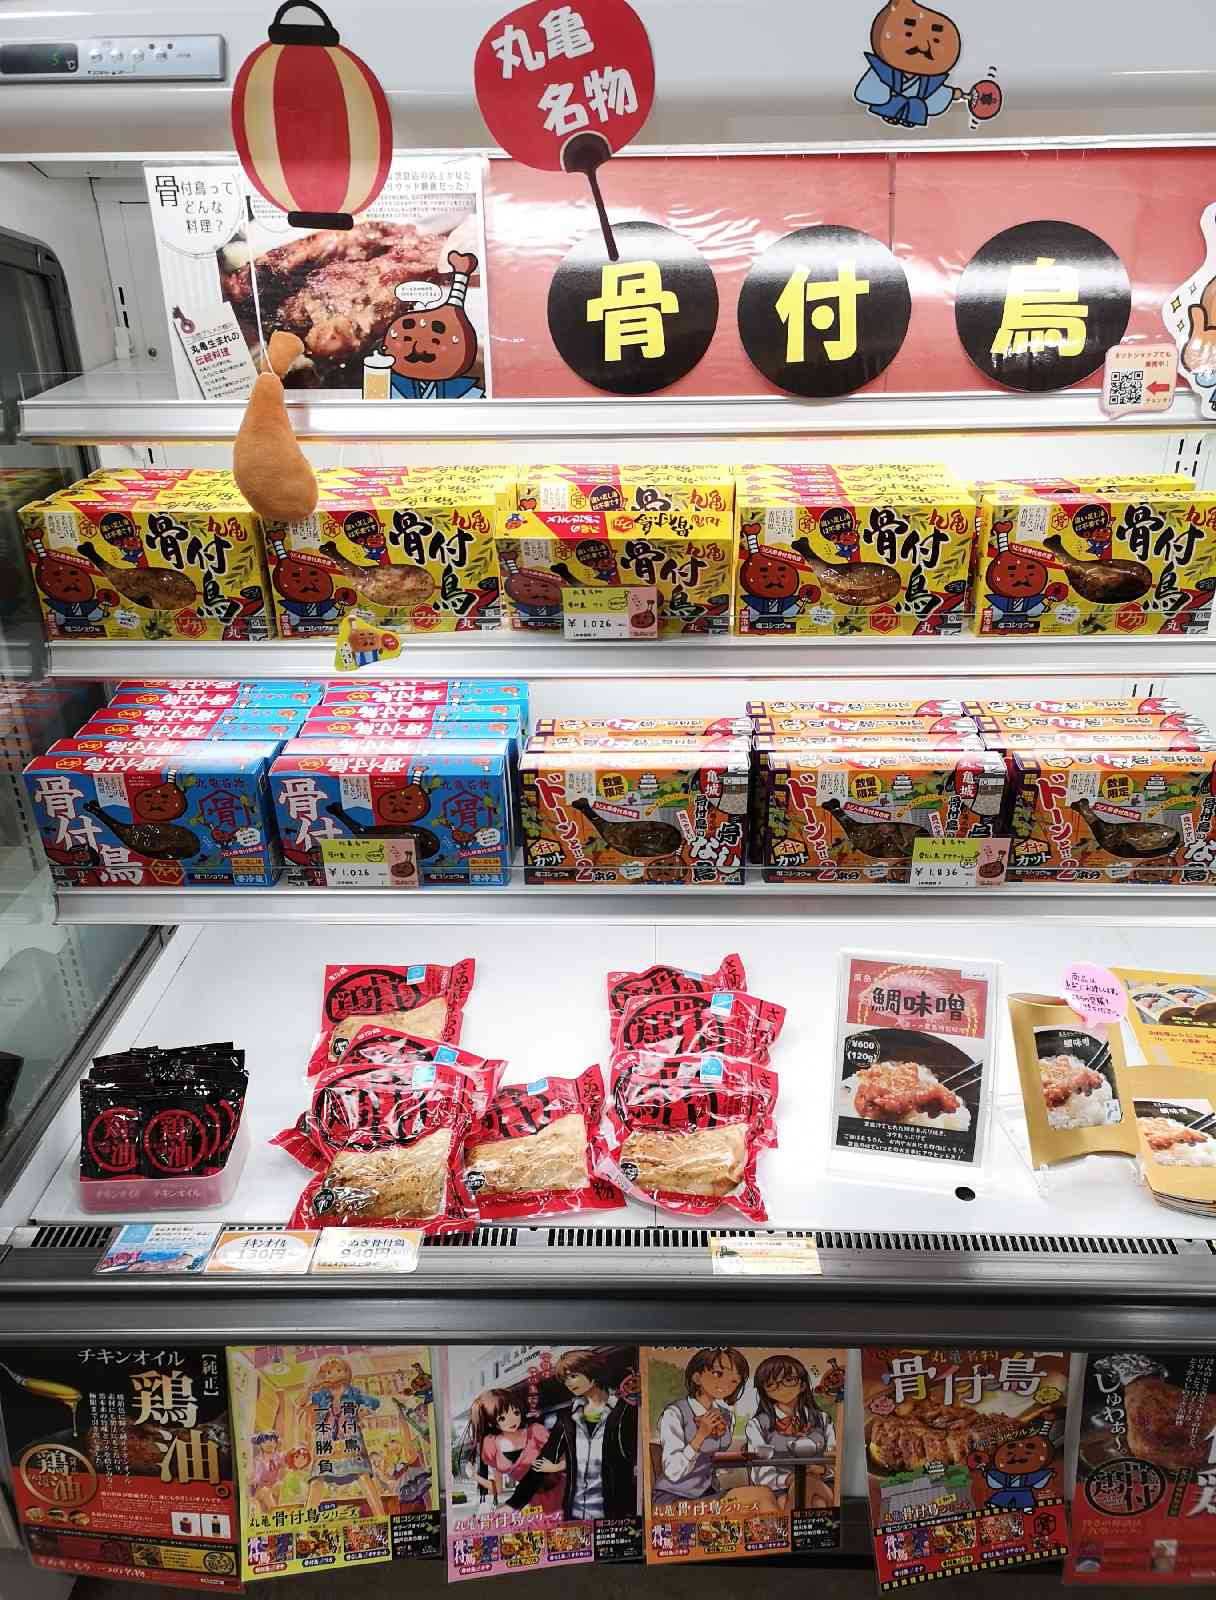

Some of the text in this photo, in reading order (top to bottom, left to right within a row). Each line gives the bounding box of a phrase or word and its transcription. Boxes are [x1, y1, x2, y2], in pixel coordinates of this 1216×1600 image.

[491, 5, 595, 80] 丸亀
[537, 66, 639, 137] 名物
[155, 174, 234, 208] 骨付鳥って
[184, 198, 224, 214] どんな
[190, 331, 240, 355] 丸亀生まれの
[567, 618, 577, 628] ¥
[601, 775, 624, 788] 数量
[854, 775, 877, 789] 数量
[1106, 776, 1129, 788] 数量
[602, 786, 626, 798] 限定
[856, 787, 878, 799] 限定
[1107, 786, 1129, 798] 限定
[277, 778, 344, 852] 骨付
[35, 775, 145, 886] 骨付鳥
[533, 853, 566, 867] カット
[775, 852, 809, 867] カット
[1015, 853, 1051, 867] カット
[328, 867, 337, 877] ¥
[914, 867, 924, 877] ¥
[871, 986, 966, 1022] 鯛味噌
[850, 1039, 875, 1051] ¥600
[238, 1238, 287, 1249] チキンオイル
[78, 1348, 185, 1367] チキンオイル
[881, 1356, 1048, 1406] 骨付鳥
[130, 1369, 221, 1485] 鶏油
[314, 1408, 333, 1474] 一本勝負
[248, 1507, 360, 1529] 丸亀骨付鳥シリーズ
